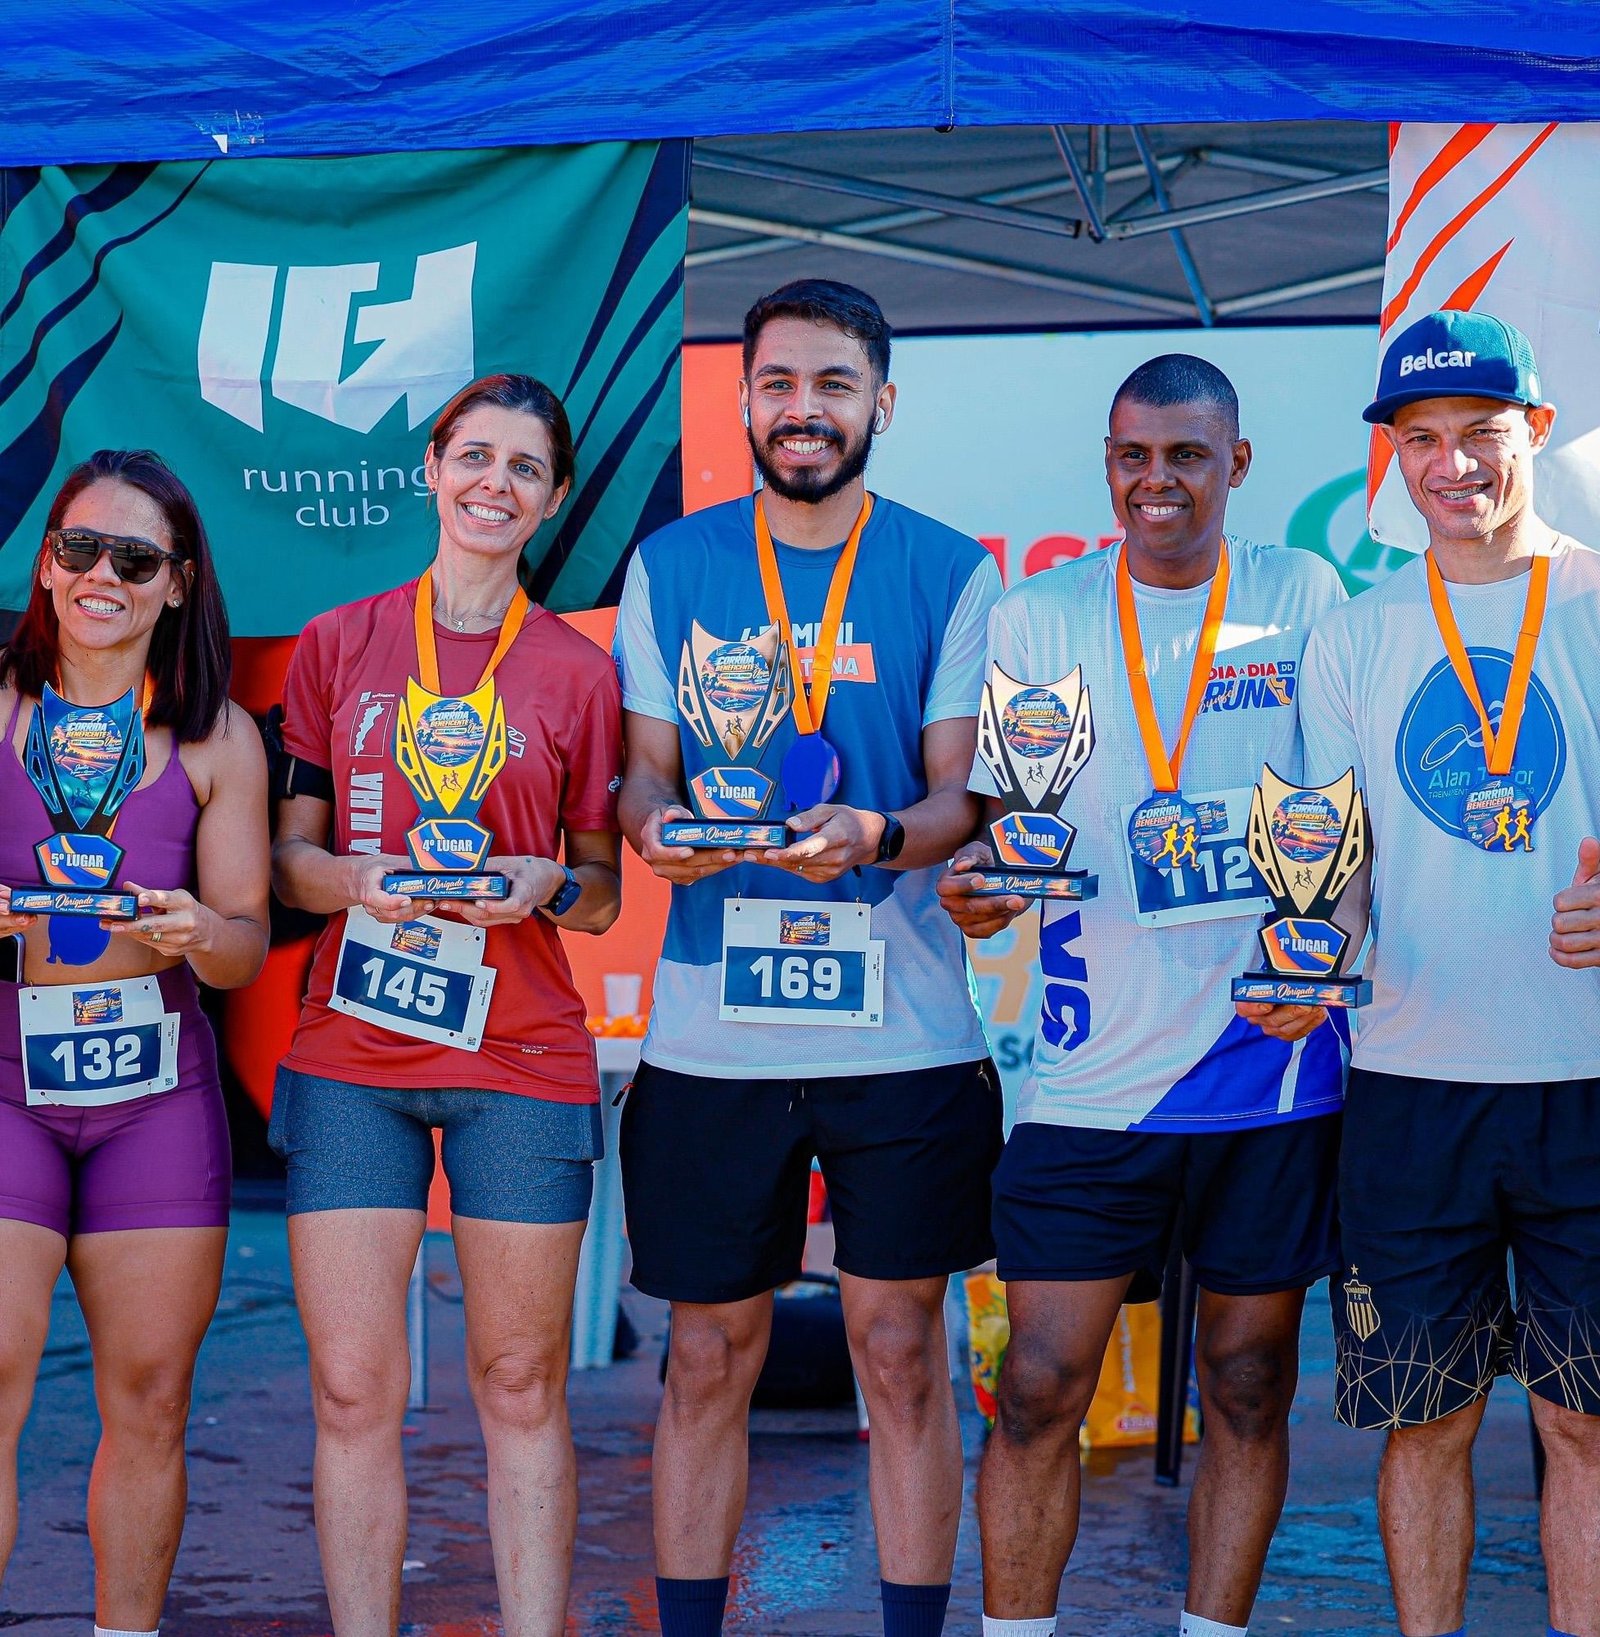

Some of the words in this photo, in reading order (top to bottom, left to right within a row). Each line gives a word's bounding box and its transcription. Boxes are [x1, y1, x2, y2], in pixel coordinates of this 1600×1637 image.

[1400, 347, 1477, 377] Belcar
[242, 458, 431, 496] running
[295, 497, 390, 527] club
[716, 655, 754, 664] CORRIDA
[716, 664, 754, 672] BENEFICENTE
[1247, 663, 1277, 677] DIA
[1201, 678, 1267, 713] RUN
[1016, 709, 1055, 717] BENEFICENTE
[1018, 701, 1055, 711] CORRIDA
[430, 711, 469, 720] CORRIDA
[66, 722, 107, 732] CORRIDA
[430, 719, 469, 728] BENEFICENTE
[1428, 768, 1471, 790] Alan
[705, 786, 718, 799] 3º
[720, 786, 756, 799] LUGAR
[1470, 786, 1514, 801] CORRIDA
[350, 772, 384, 833] ILHA
[1288, 804, 1328, 814] CORRIDA
[1466, 797, 1514, 811] BENEFICENTE
[1139, 804, 1182, 819] CORRIDA
[1286, 813, 1328, 821] BENEFICENTE
[1135, 815, 1180, 828] BENEFICENTE
[706, 826, 744, 841] Obrigado
[1005, 831, 1018, 845] 2º
[1020, 833, 1056, 847] LUGAR
[422, 839, 435, 852] 4º
[437, 839, 473, 852] LUGAR
[51, 853, 64, 866] 5º
[67, 854, 104, 868] LUGAR
[1157, 846, 1253, 898] 112
[427, 878, 464, 893] Obrigado
[1005, 877, 1043, 890] Obrigado
[55, 893, 94, 907] Obrigado
[1279, 937, 1290, 951] 1º
[1292, 938, 1329, 953] LUGAR
[749, 955, 842, 1001] 169
[361, 956, 449, 1017] 145
[1277, 983, 1315, 998] Obrigado
[50, 1034, 142, 1082] 132
